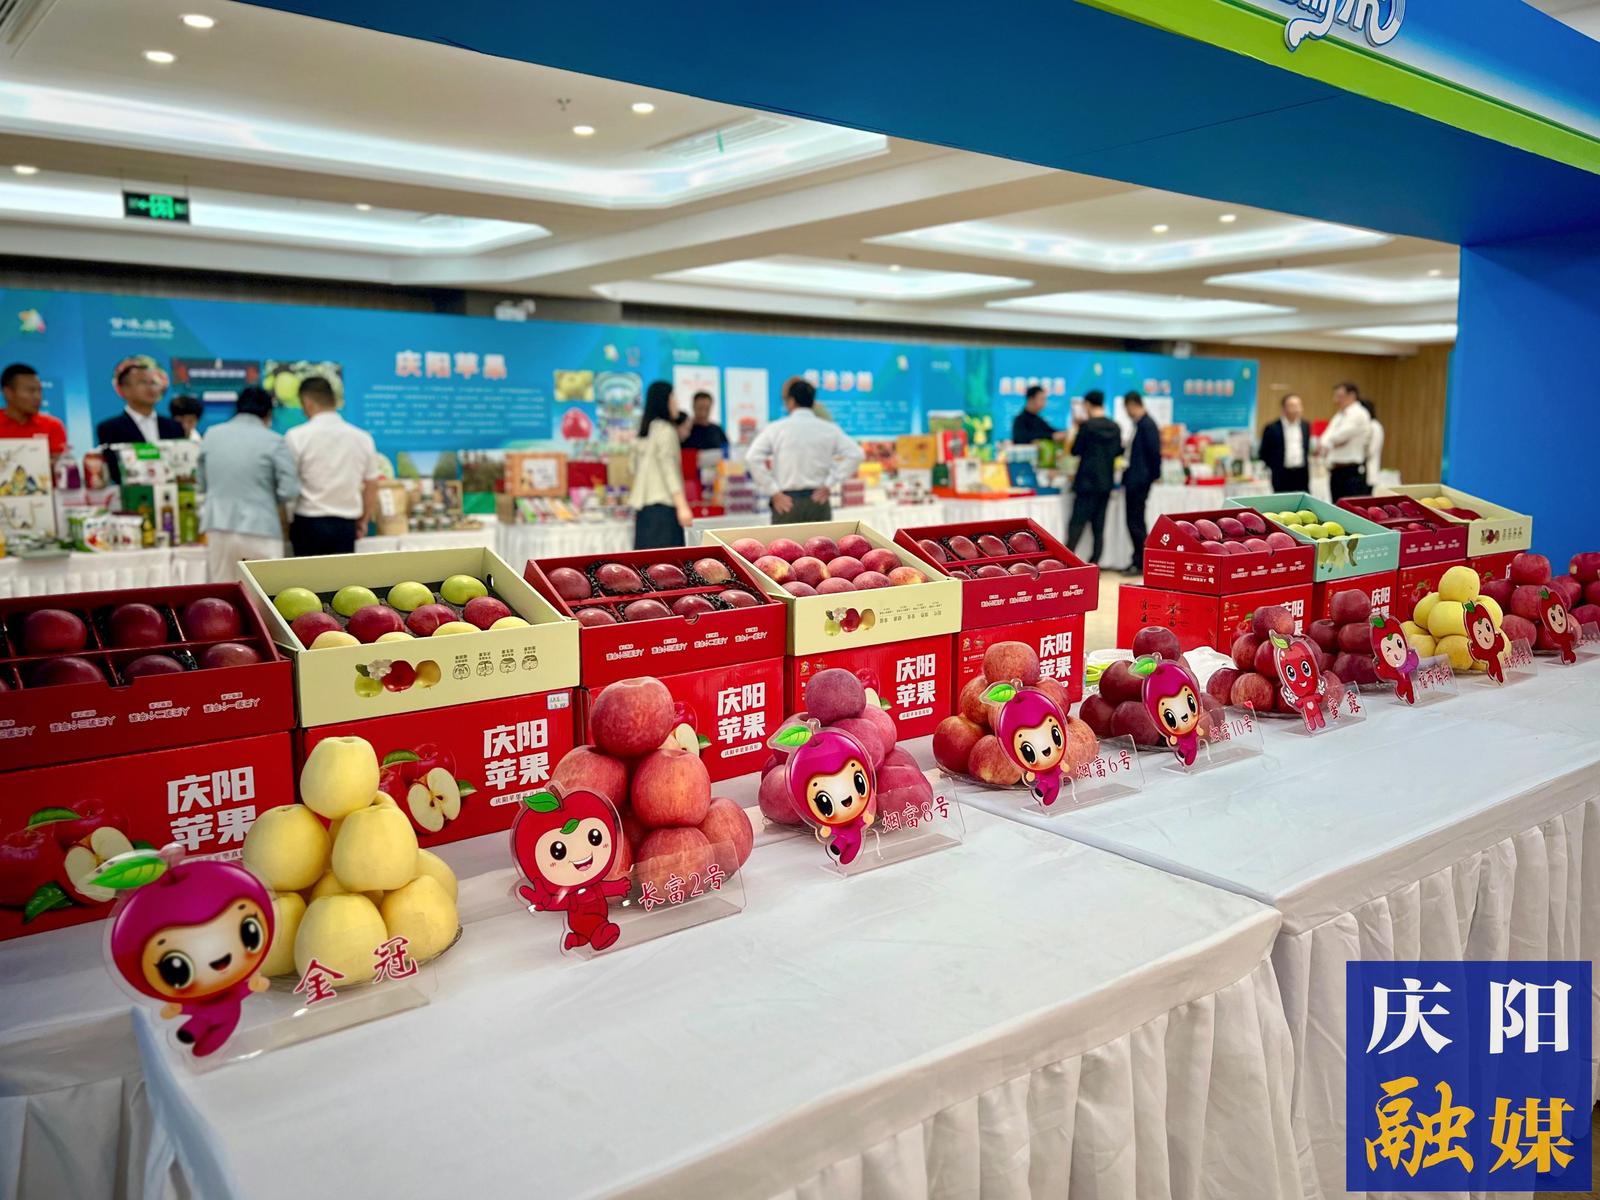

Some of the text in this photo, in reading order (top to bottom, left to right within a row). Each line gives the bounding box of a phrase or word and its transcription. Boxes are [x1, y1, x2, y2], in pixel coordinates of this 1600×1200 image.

[1371, 586, 1391, 606] 庆阳
[1040, 632, 1072, 658] 庆阳
[896, 653, 936, 683] 庆阳
[1039, 656, 1071, 678] 苹果
[717, 682, 766, 716] 庆阳
[896, 679, 936, 708] 苹果
[483, 718, 549, 759] 庆阳
[717, 711, 766, 745] 苹果
[485, 751, 550, 790] 苹果
[1076, 750, 1131, 780] 烟富6号
[167, 766, 255, 815] 庆阳
[170, 805, 256, 851] 苹果
[882, 796, 950, 833] 烟富8号
[638, 864, 725, 912] 长富2号
[293, 936, 418, 1006] 金冠
